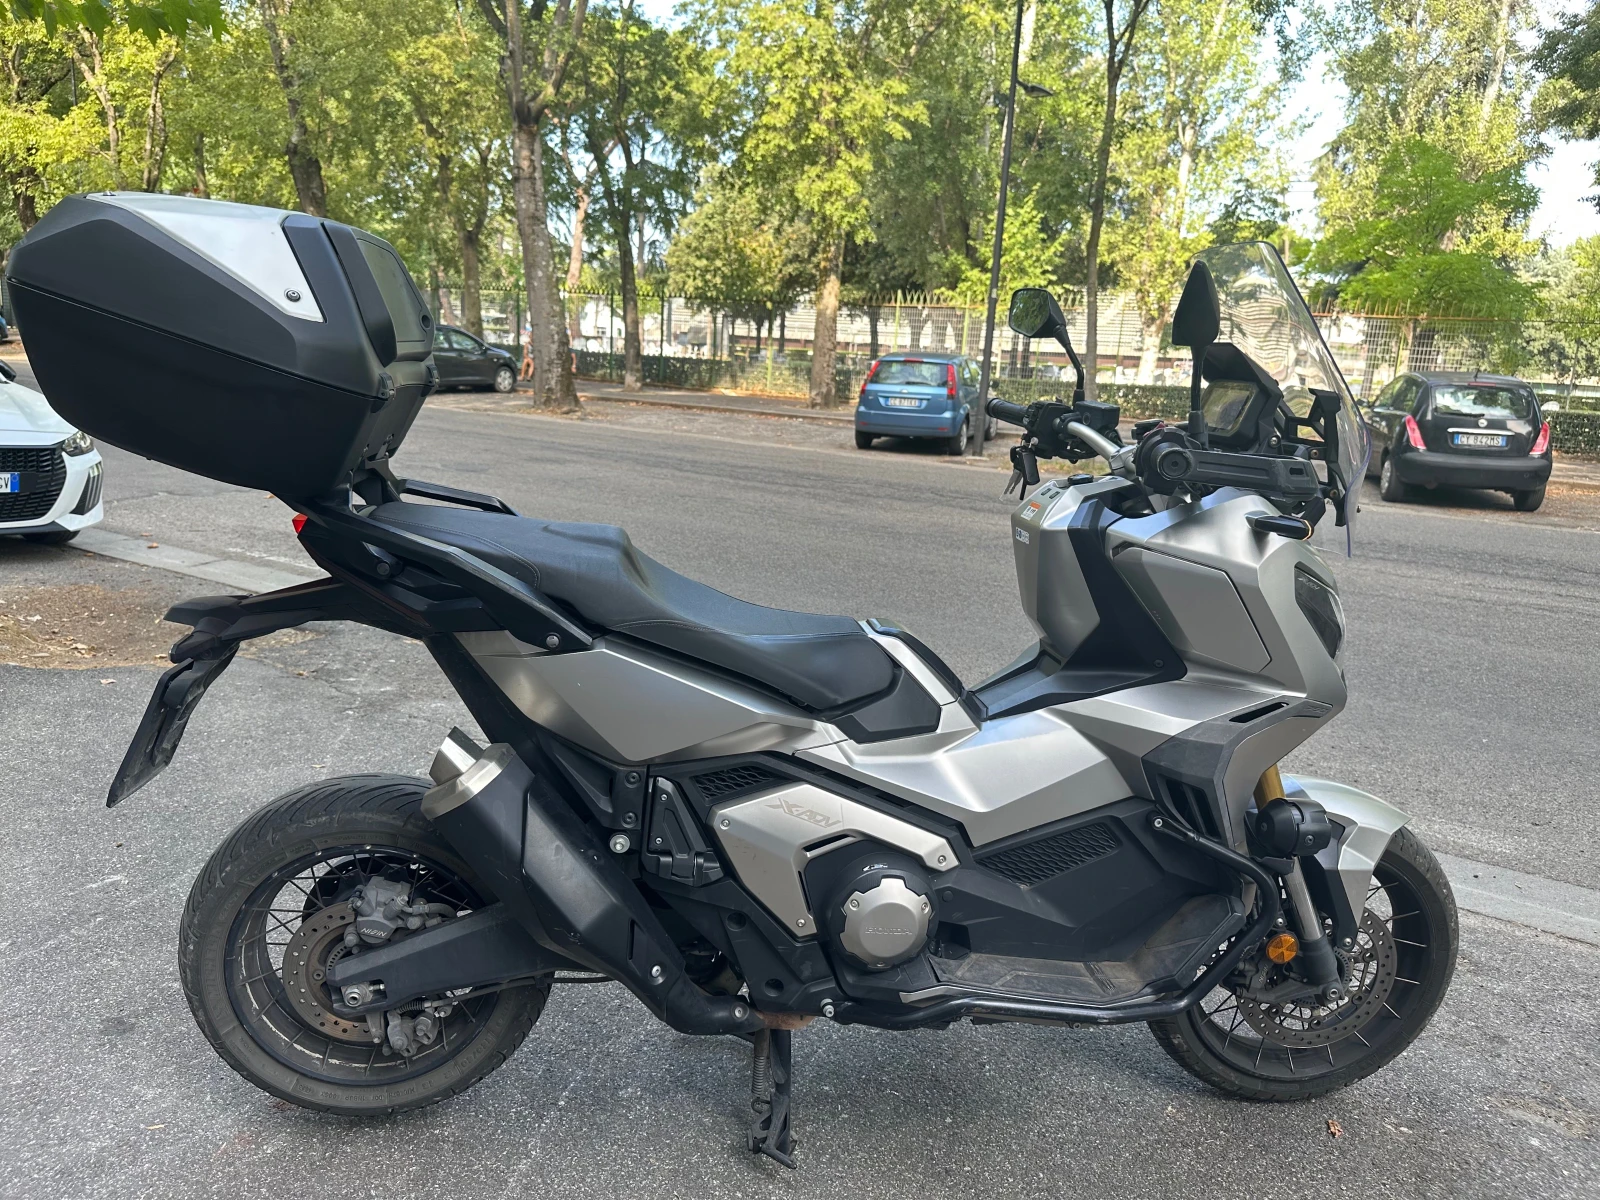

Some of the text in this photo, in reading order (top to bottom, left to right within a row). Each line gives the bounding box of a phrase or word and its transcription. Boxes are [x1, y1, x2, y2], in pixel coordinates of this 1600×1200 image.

[1460, 434, 1500, 447] CY 842MS
[764, 797, 843, 829] X-ADV
[864, 926, 913, 936] HONDA
